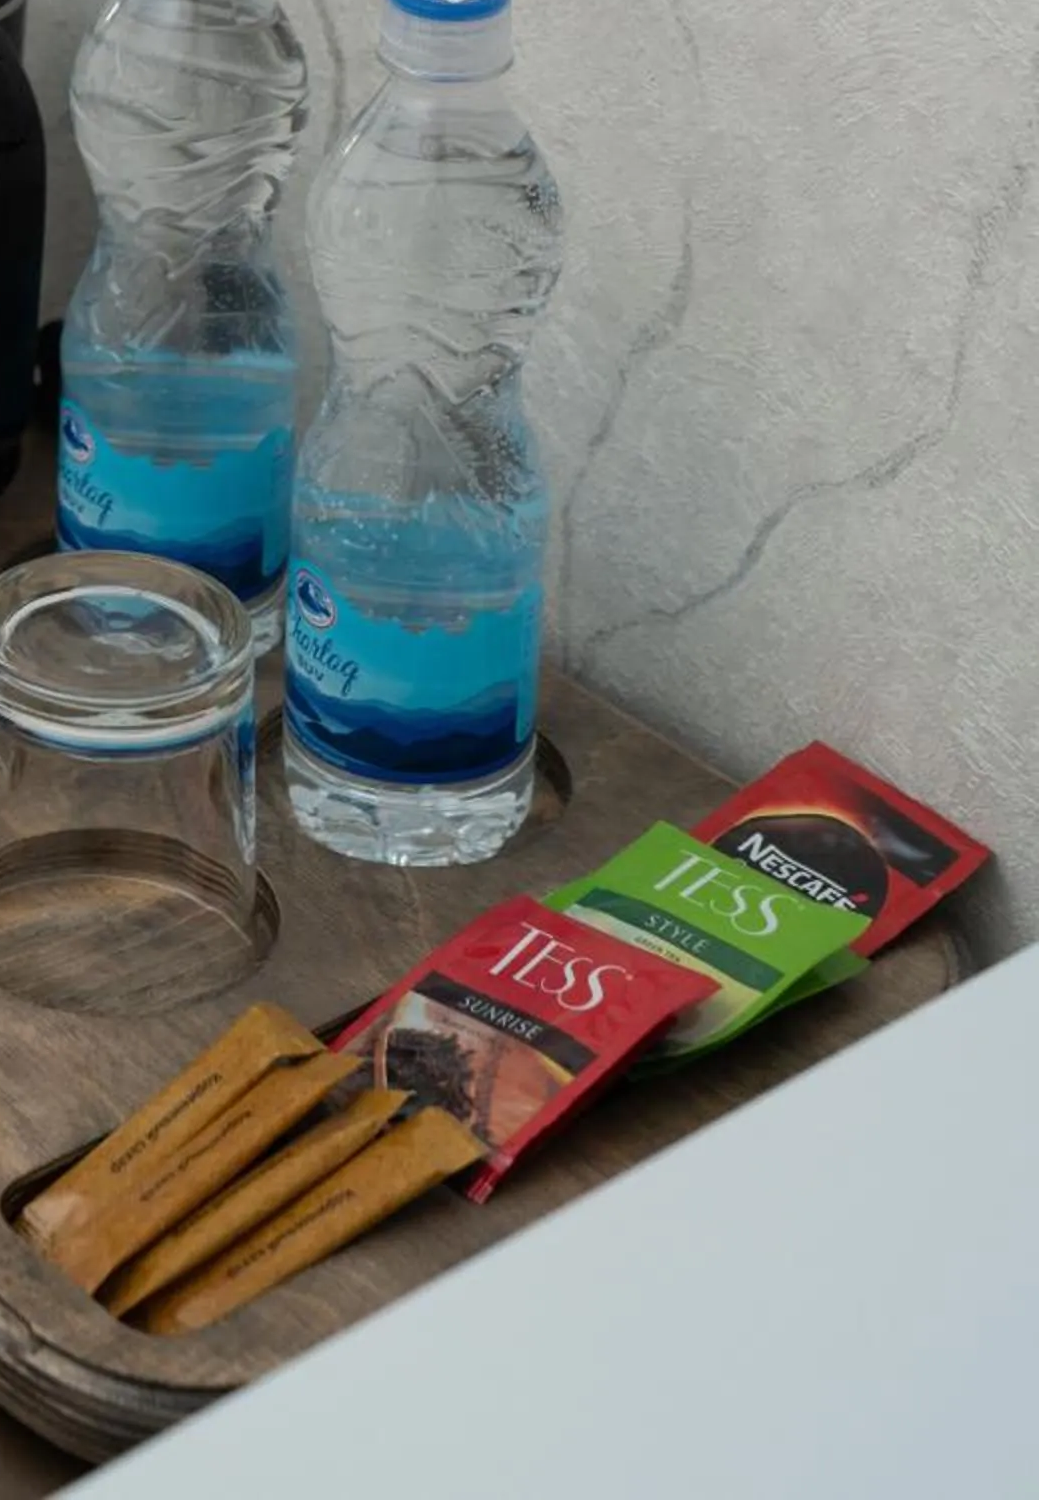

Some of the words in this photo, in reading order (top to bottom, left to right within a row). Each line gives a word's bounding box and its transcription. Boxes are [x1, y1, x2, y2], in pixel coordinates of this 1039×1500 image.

[652, 849, 801, 937] TESS
[488, 921, 628, 1012] TESS
[643, 913, 711, 953] STYLE
[458, 995, 544, 1041] SUNRISE
